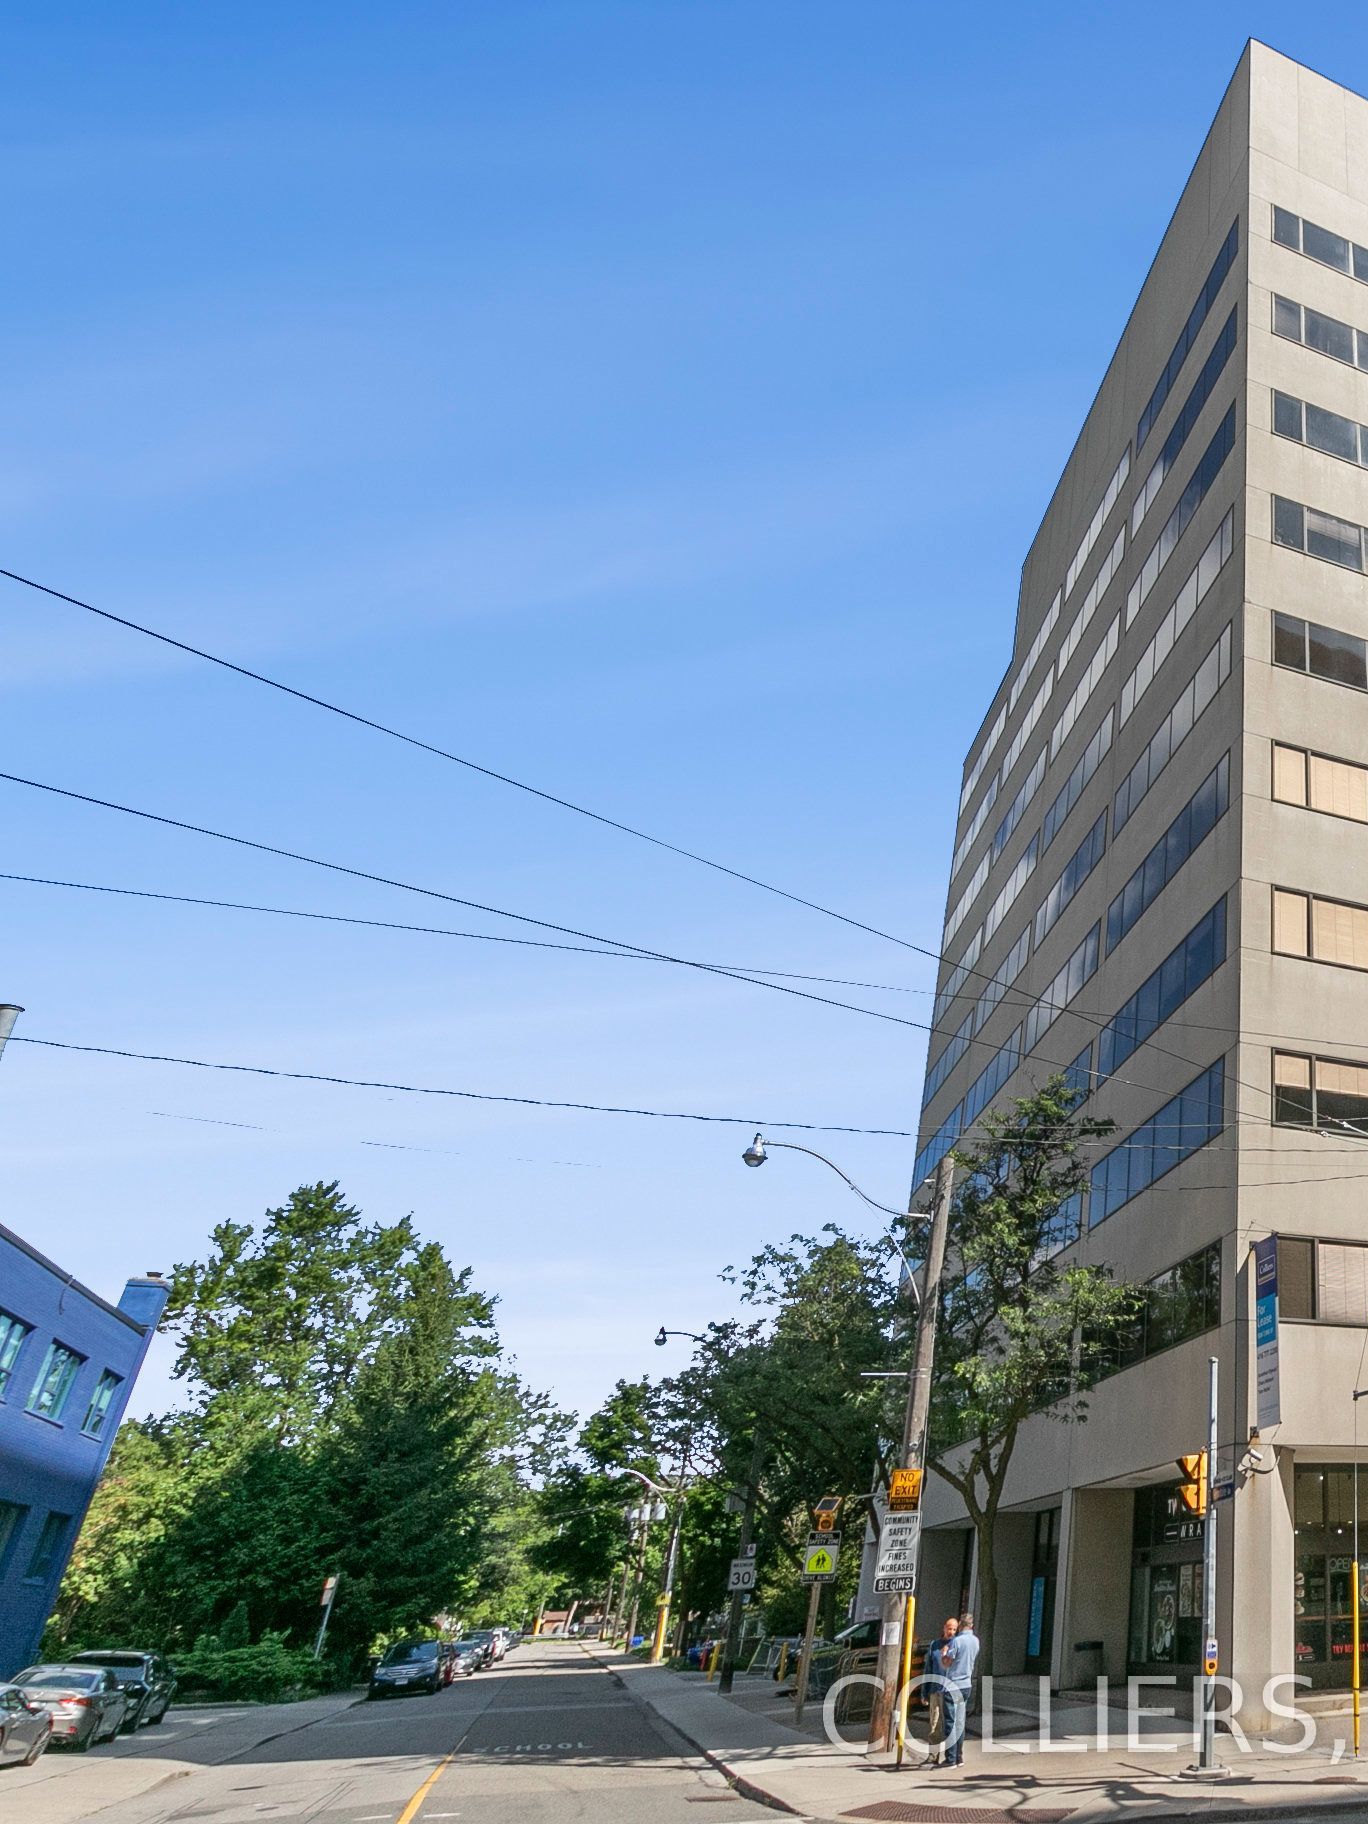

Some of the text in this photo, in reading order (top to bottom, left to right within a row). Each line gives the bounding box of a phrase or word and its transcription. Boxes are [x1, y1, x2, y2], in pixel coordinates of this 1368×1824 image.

[1257, 1305, 1266, 1314] For
[1258, 1314, 1272, 1328] Lease
[900, 1472, 915, 1482] NO
[895, 1485, 917, 1496] EXIT
[885, 1516, 918, 1526] COMMUNITY
[889, 1527, 912, 1537] SAFETY
[890, 1539, 907, 1548] ZONE
[888, 1552, 907, 1560] FINES
[879, 1563, 914, 1573] INCREASED
[731, 1572, 752, 1586] 30
[878, 1578, 911, 1590] BEGINS
[1333, 1645, 1344, 1654] TRY
[1344, 1643, 1366, 1653] BEFRE
[473, 1742, 594, 1753] SCHOOL
